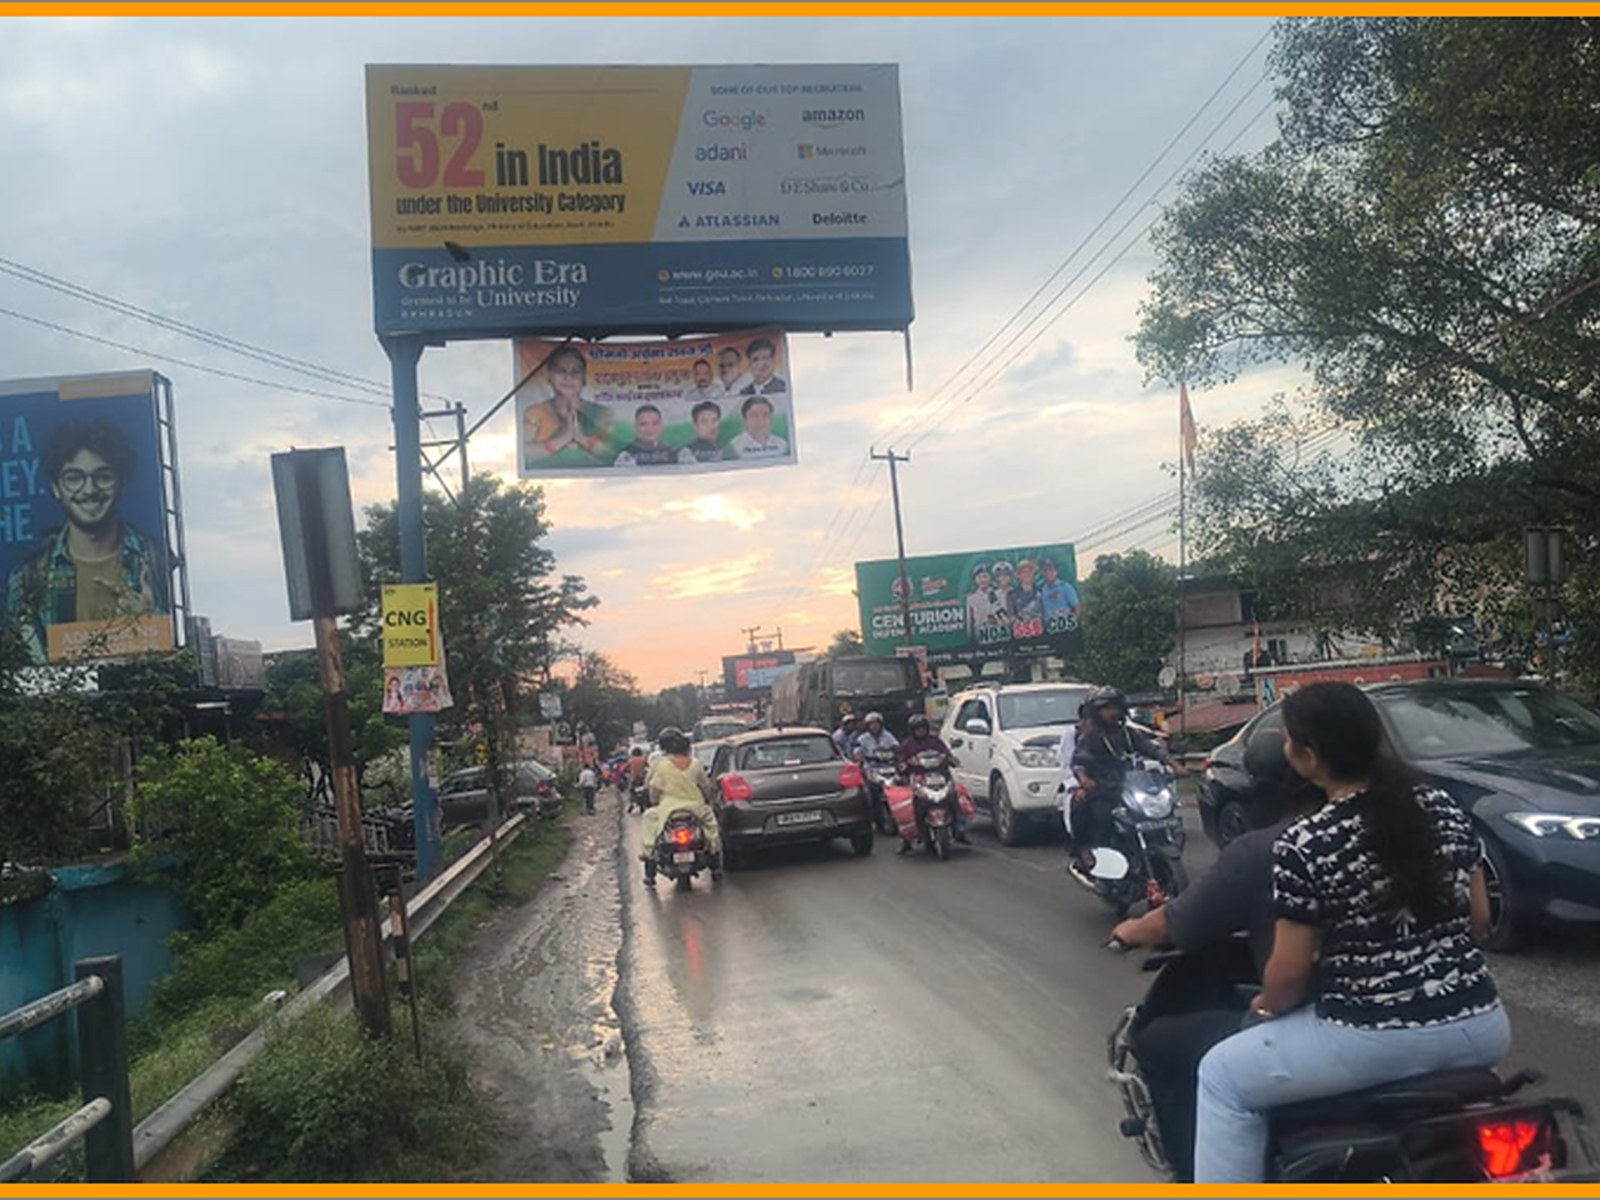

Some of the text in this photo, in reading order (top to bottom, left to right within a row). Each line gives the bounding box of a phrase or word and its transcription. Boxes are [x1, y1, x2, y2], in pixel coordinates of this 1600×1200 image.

[703, 110, 767, 130] Google
[802, 108, 865, 123] amazon
[696, 142, 747, 162] adani
[816, 145, 867, 157] Microsoft
[496, 143, 529, 187] in
[538, 140, 623, 186] India
[688, 181, 726, 196] VISA
[396, 191, 625, 216] under the University Category
[696, 215, 780, 227] ATLASSIAN
[813, 213, 868, 225] Deloitte
[399, 257, 588, 293] Graphic Era
[477, 285, 580, 308] University
[12, 415, 32, 453] A
[386, 610, 427, 627] CNG
[872, 608, 964, 629] CENURION
[388, 638, 427, 649] STATION
